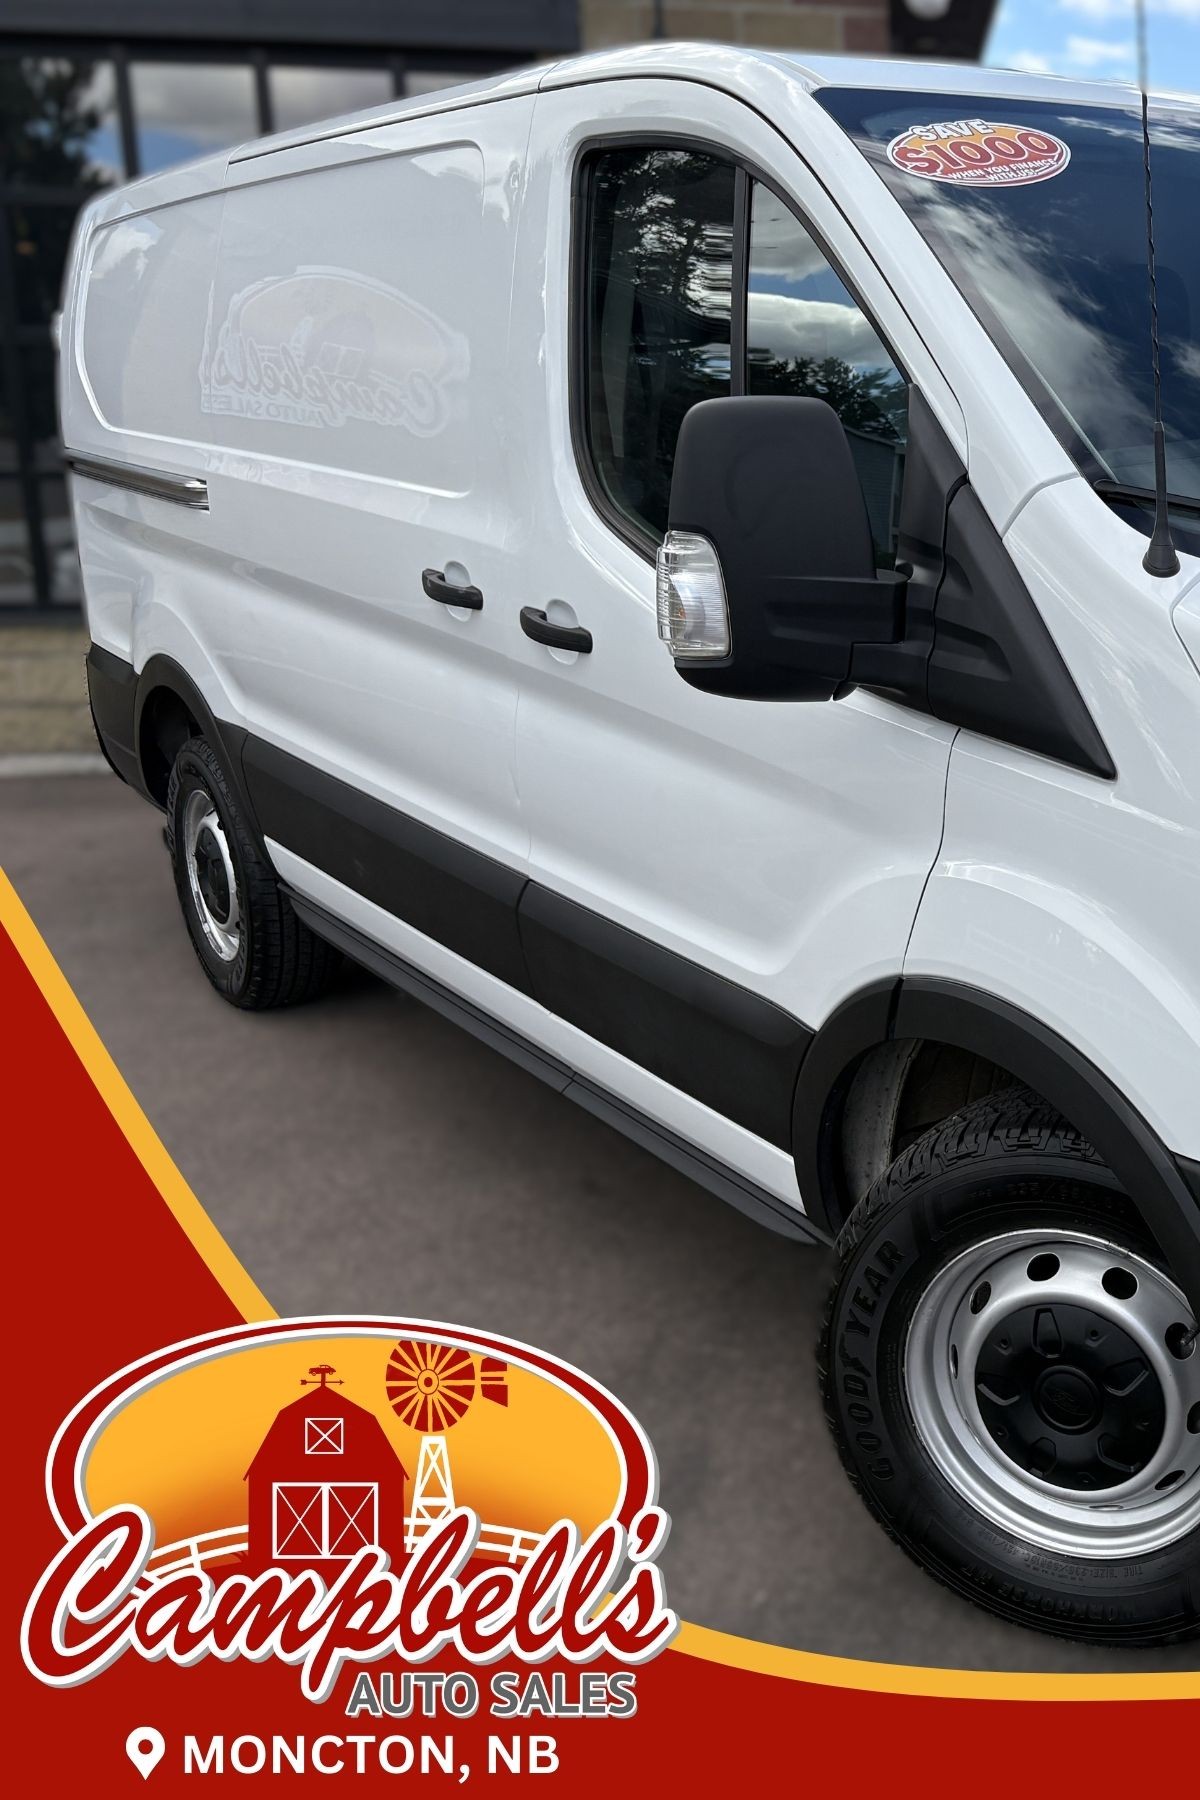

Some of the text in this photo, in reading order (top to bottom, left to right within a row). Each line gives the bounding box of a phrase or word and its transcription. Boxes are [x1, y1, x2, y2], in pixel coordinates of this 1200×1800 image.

[911, 120, 994, 141] SAVE
[892, 130, 1061, 176] $1000
[948, 158, 1057, 180] WHEN YOU FINANCE
[986, 170, 1016, 181] WITH
